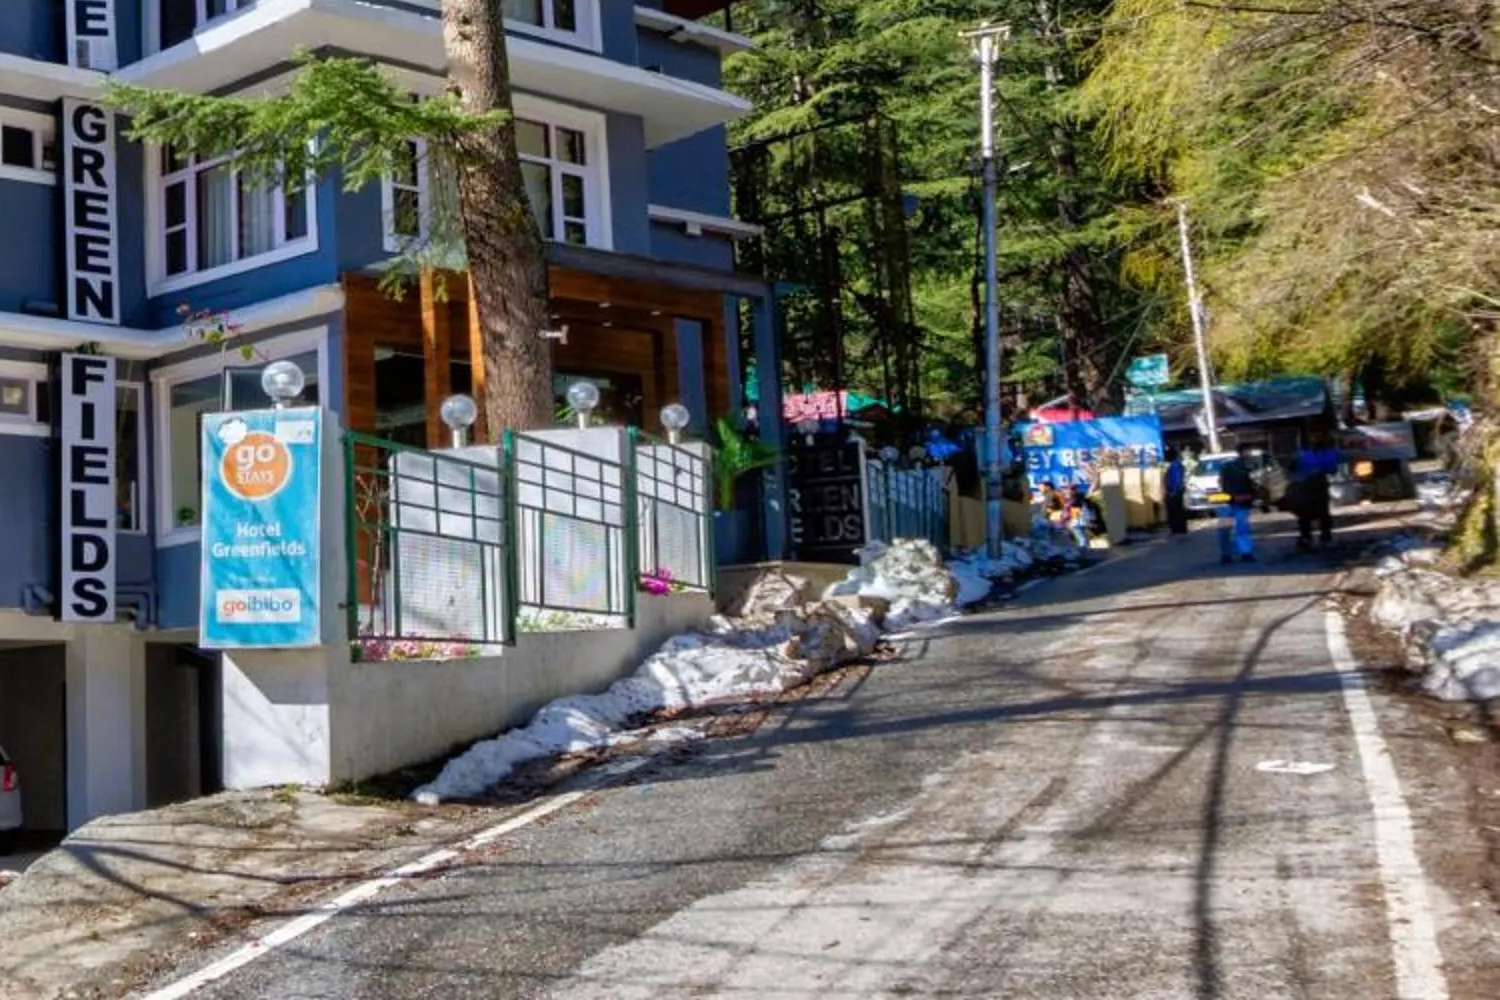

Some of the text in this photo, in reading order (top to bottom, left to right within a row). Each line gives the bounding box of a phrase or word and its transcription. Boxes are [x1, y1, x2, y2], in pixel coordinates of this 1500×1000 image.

[72, 105, 113, 319] GREEN
[236, 443, 276, 472] go
[70, 357, 109, 617] FIELDS
[236, 521, 282, 537] Hotel
[212, 539, 306, 558] Greenfields
[222, 594, 294, 617] goibibo
